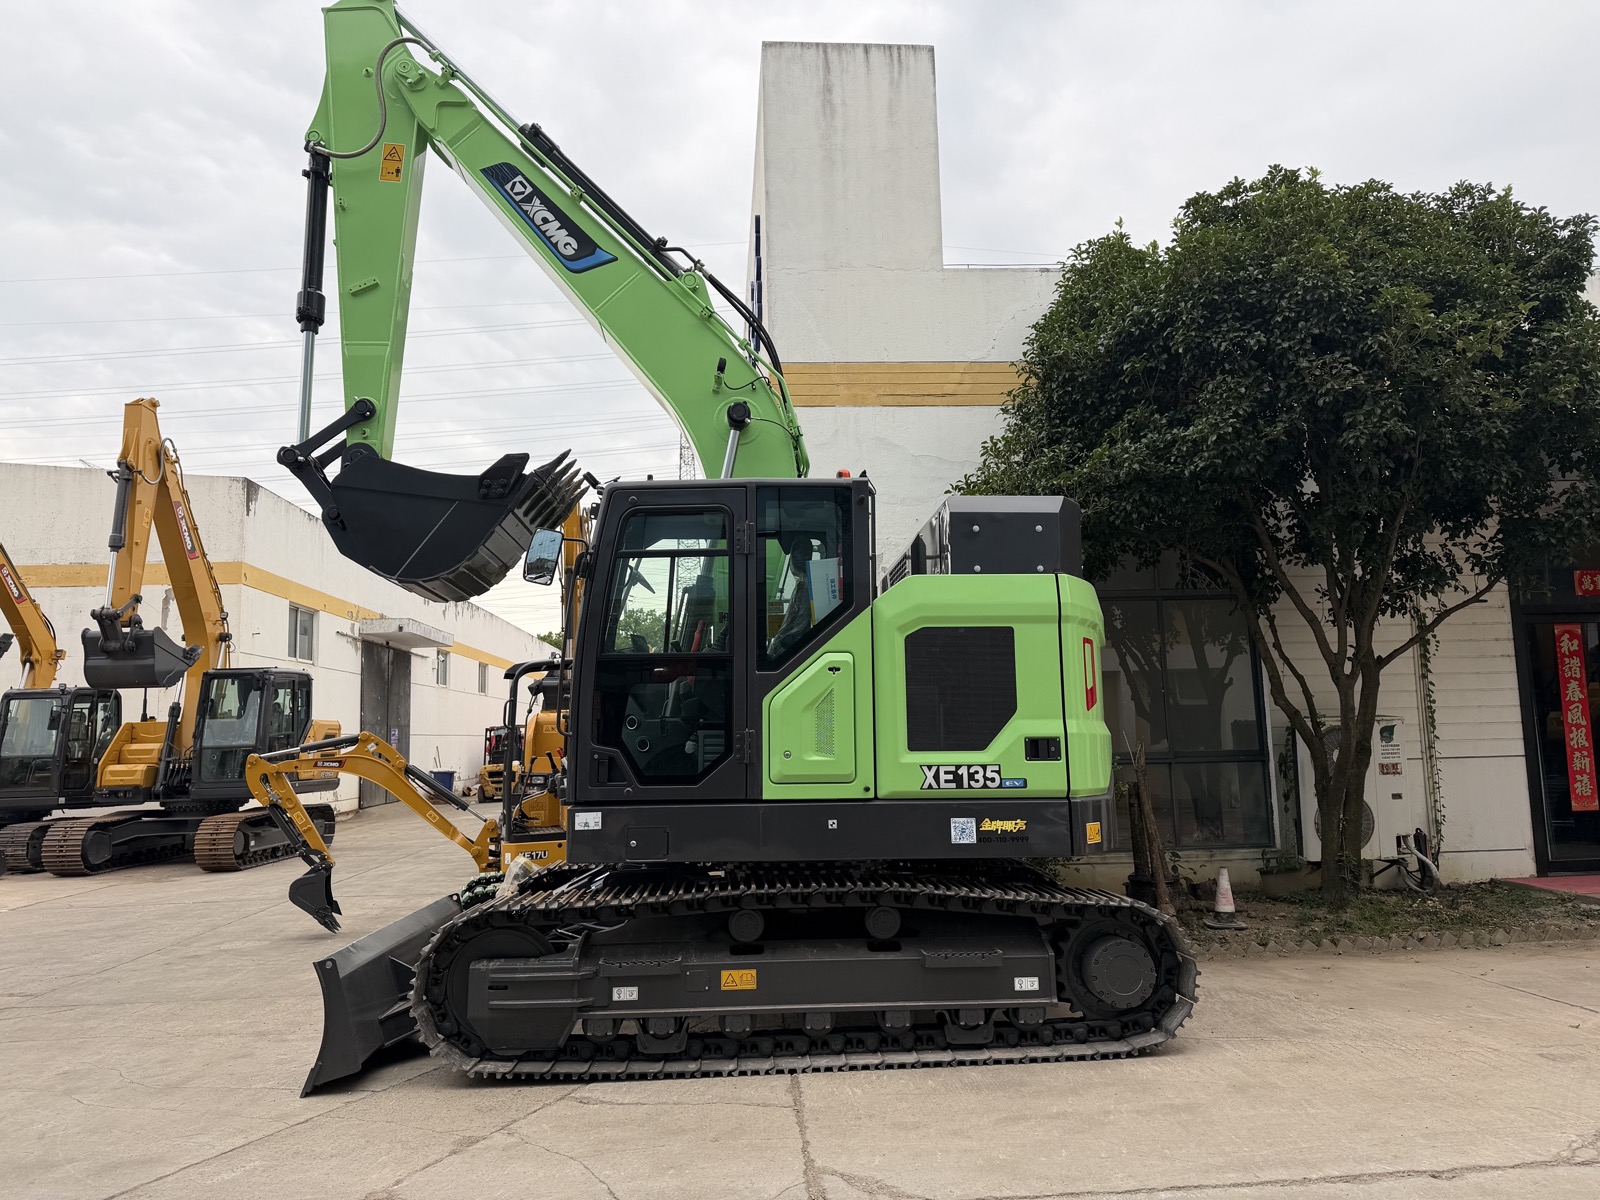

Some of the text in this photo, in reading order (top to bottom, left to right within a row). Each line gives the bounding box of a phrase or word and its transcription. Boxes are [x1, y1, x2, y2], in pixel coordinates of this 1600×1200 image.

[519, 195, 578, 256] XCMG
[180, 518, 192, 550] XCMG
[5, 575, 19, 598] XCMG
[921, 765, 1001, 789] XE135
[979, 817, 1027, 834] 金牌服务
